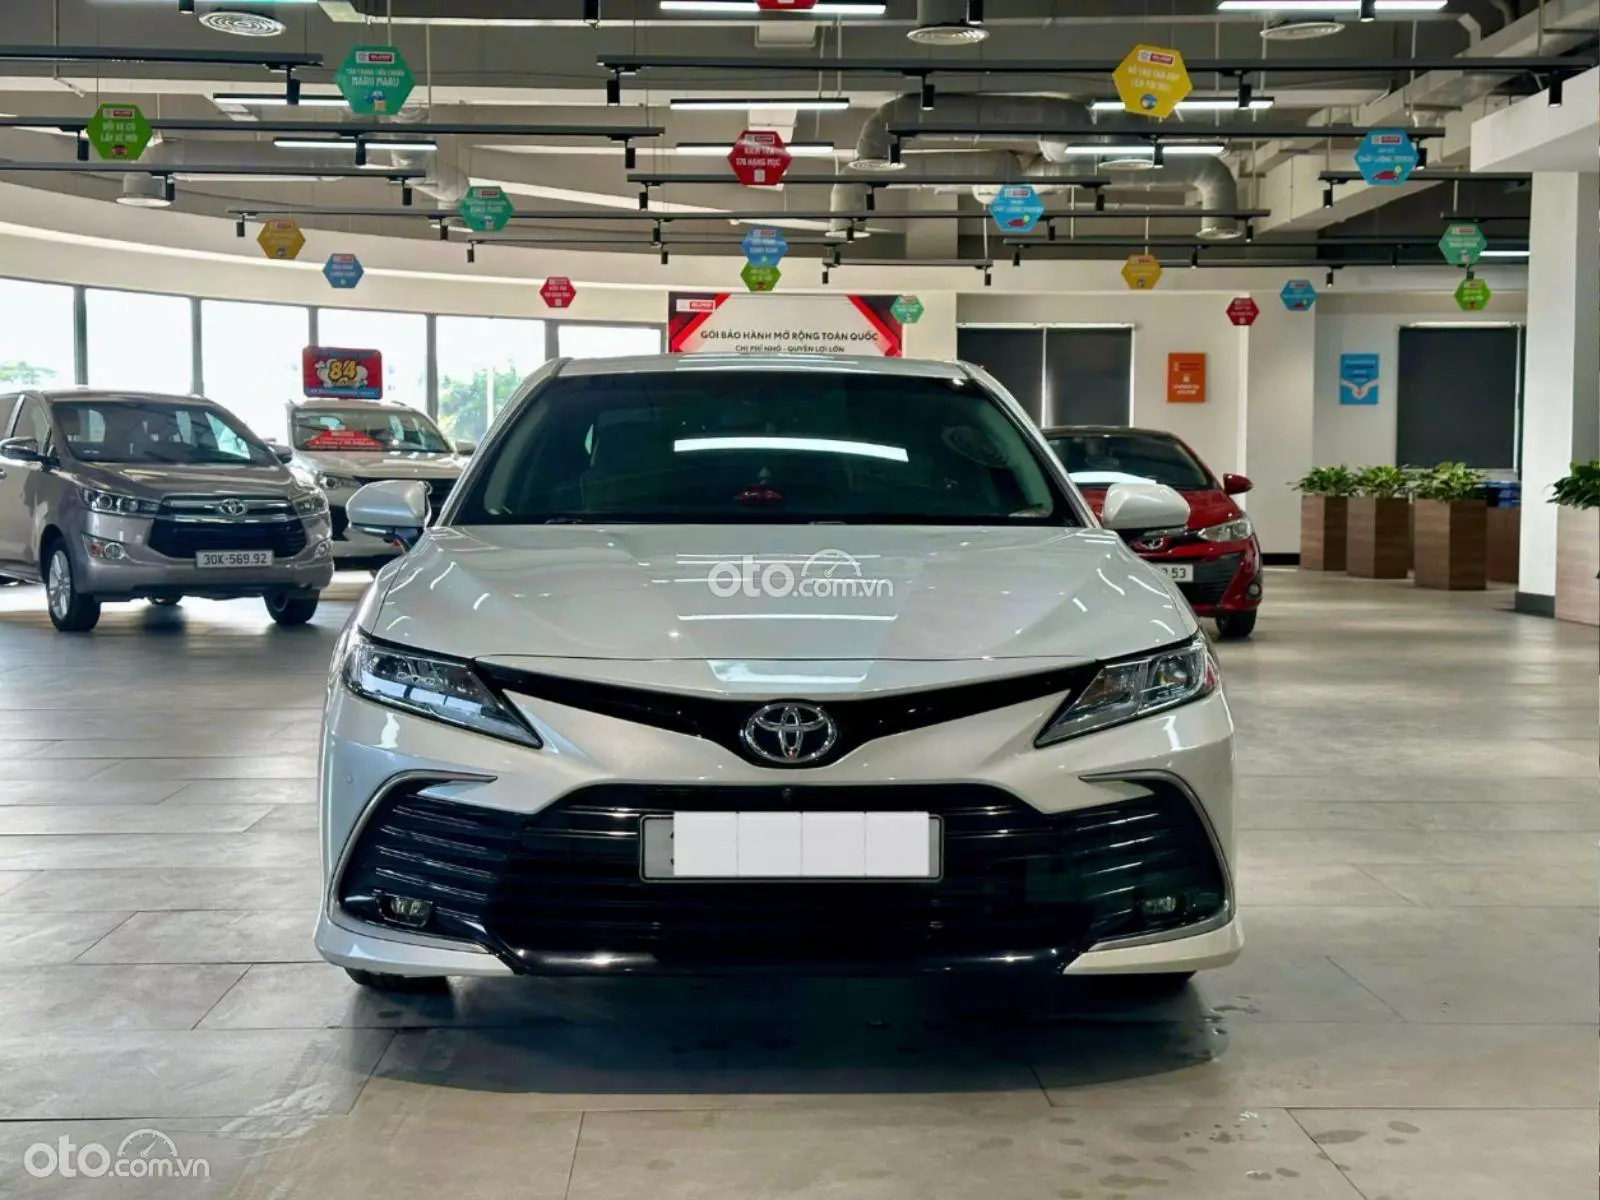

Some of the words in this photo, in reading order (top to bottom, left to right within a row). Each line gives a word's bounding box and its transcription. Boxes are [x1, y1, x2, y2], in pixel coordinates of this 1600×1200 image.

[376, 76, 399, 87] MARU
[701, 330, 719, 339] GÓI
[721, 329, 741, 339] BẢO
[743, 330, 771, 340] HÀNH
[774, 330, 790, 340] MỞ
[792, 330, 820, 341] RỘNG
[821, 331, 848, 340] TOÀN
[850, 331, 878, 340] QUỐC
[203, 553, 267, 566] 30K-569.92
